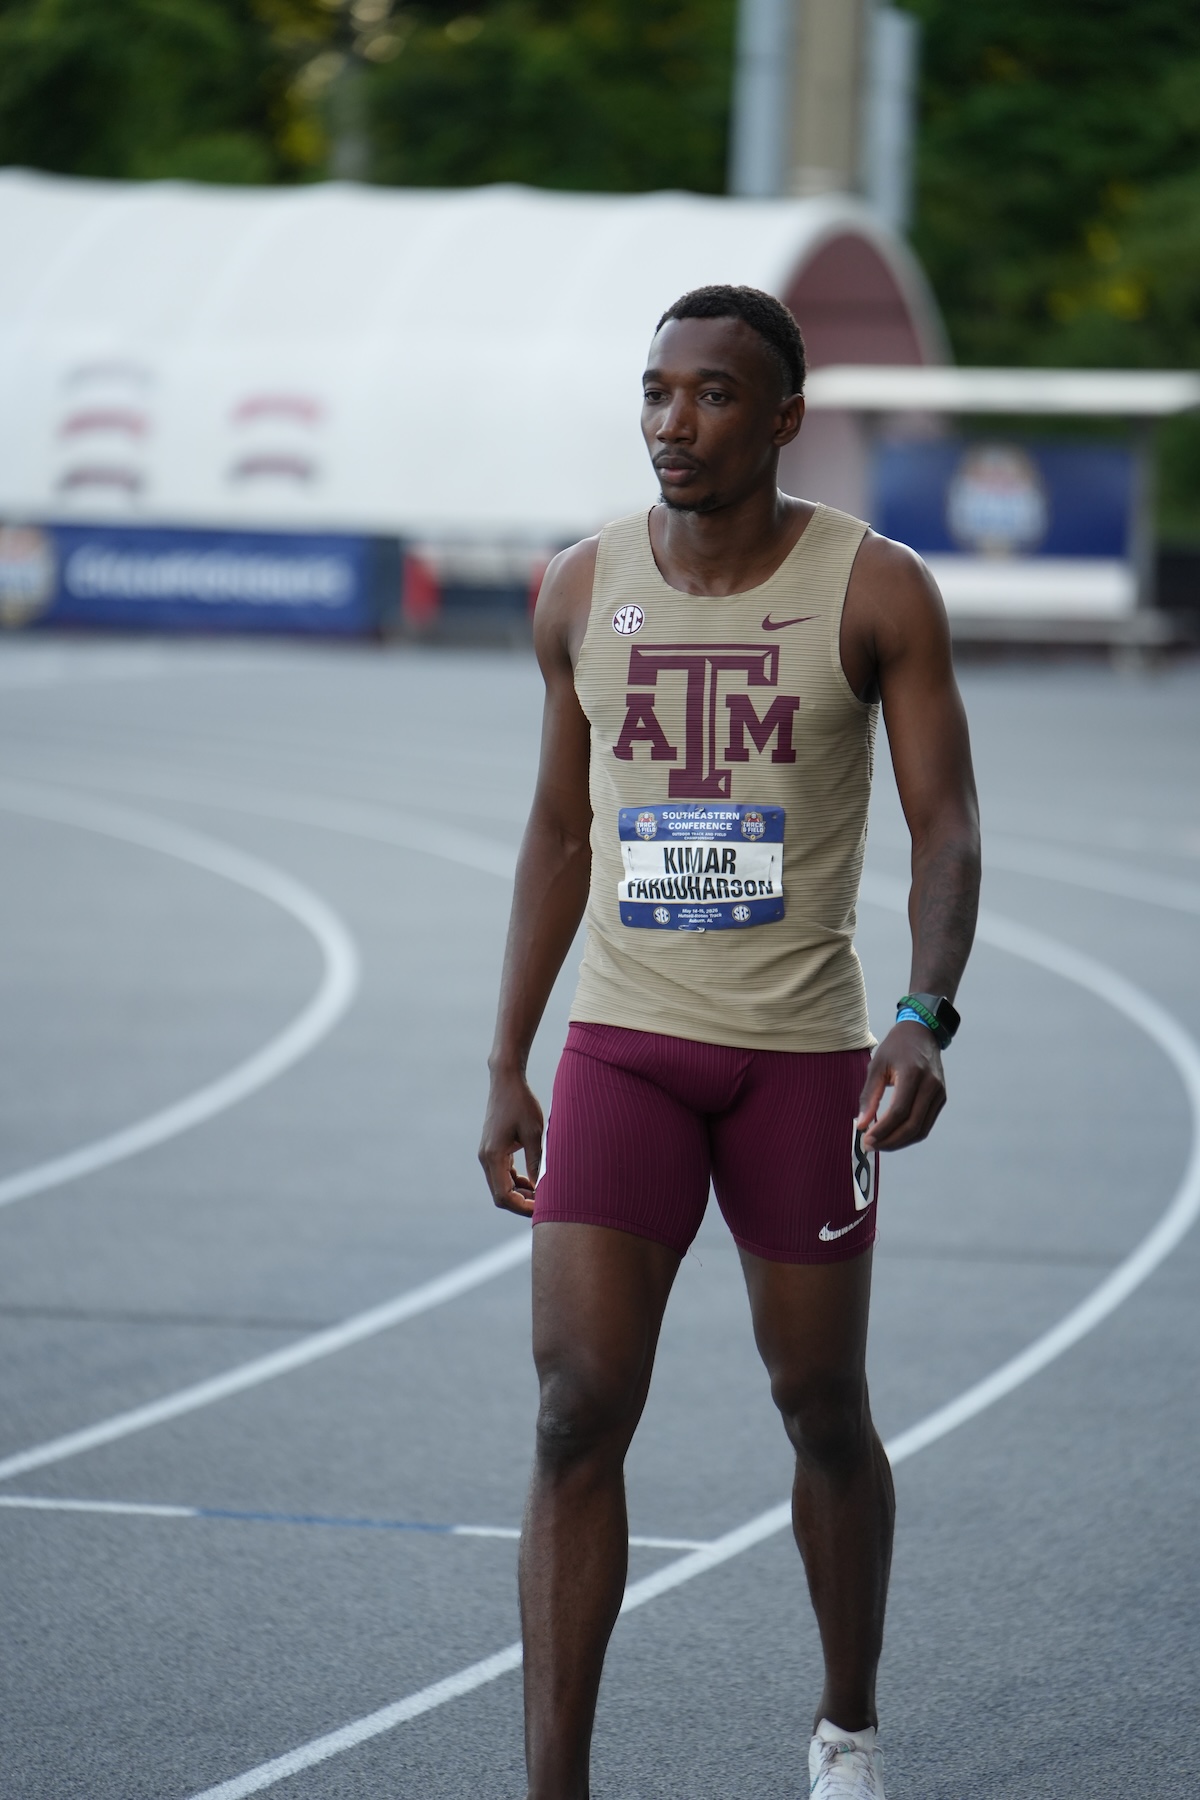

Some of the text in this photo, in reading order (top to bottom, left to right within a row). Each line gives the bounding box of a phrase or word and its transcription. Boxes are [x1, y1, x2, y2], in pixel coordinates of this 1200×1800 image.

[614, 605, 644, 635] SEC
[662, 811, 740, 820] SOUTHEASTERN
[668, 821, 733, 831] CONFERENCE
[663, 847, 737, 875] KIMAR
[627, 875, 774, 900] FARQUHARSON
[654, 908, 670, 923] SEC
[733, 906, 750, 922] SEC
